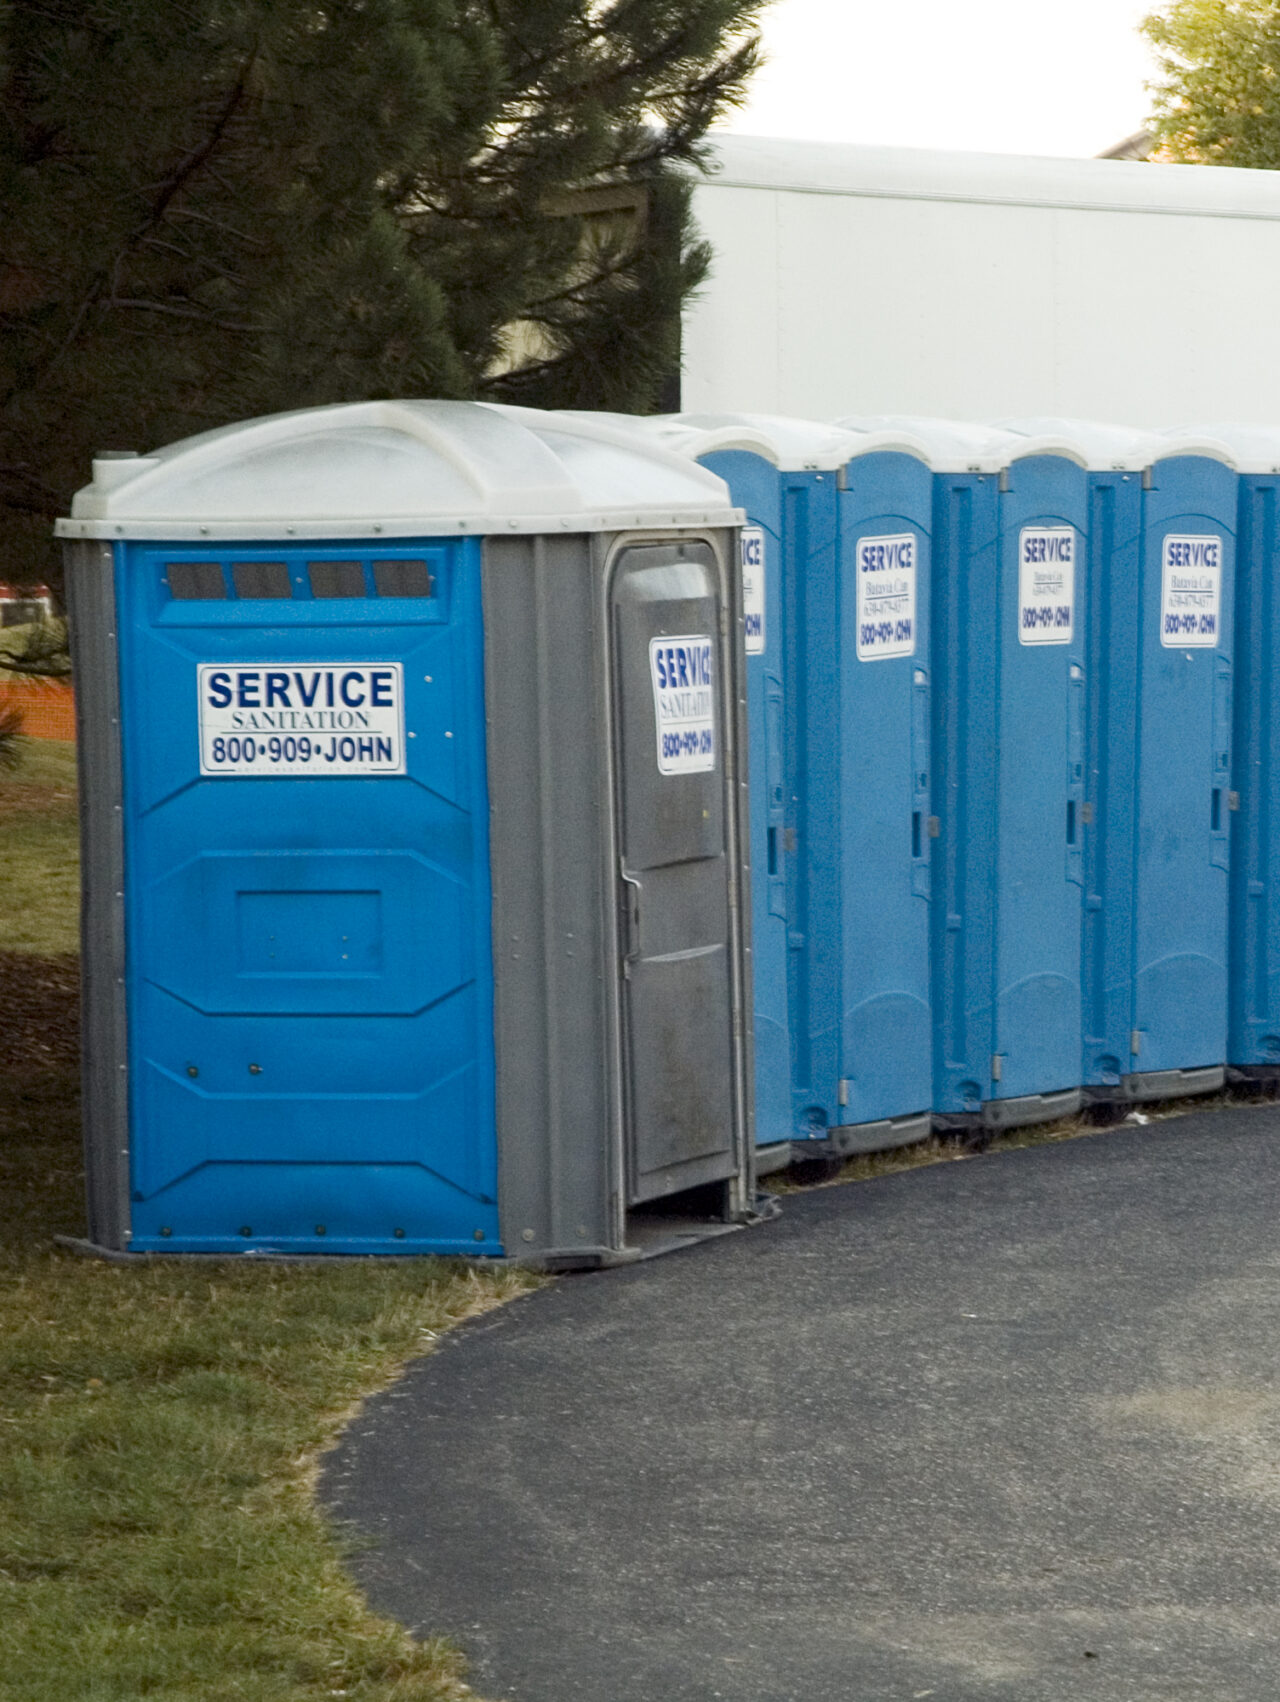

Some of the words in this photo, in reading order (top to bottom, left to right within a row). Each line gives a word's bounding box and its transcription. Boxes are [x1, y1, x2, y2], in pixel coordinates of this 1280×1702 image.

[861, 542, 912, 572] SERVICE
[1024, 537, 1071, 563] SERVICE
[1167, 542, 1218, 567] SERVICE
[208, 671, 393, 708] SERVICE
[232, 710, 369, 730] SANITATION
[212, 736, 392, 763] 800•909•JOHN
